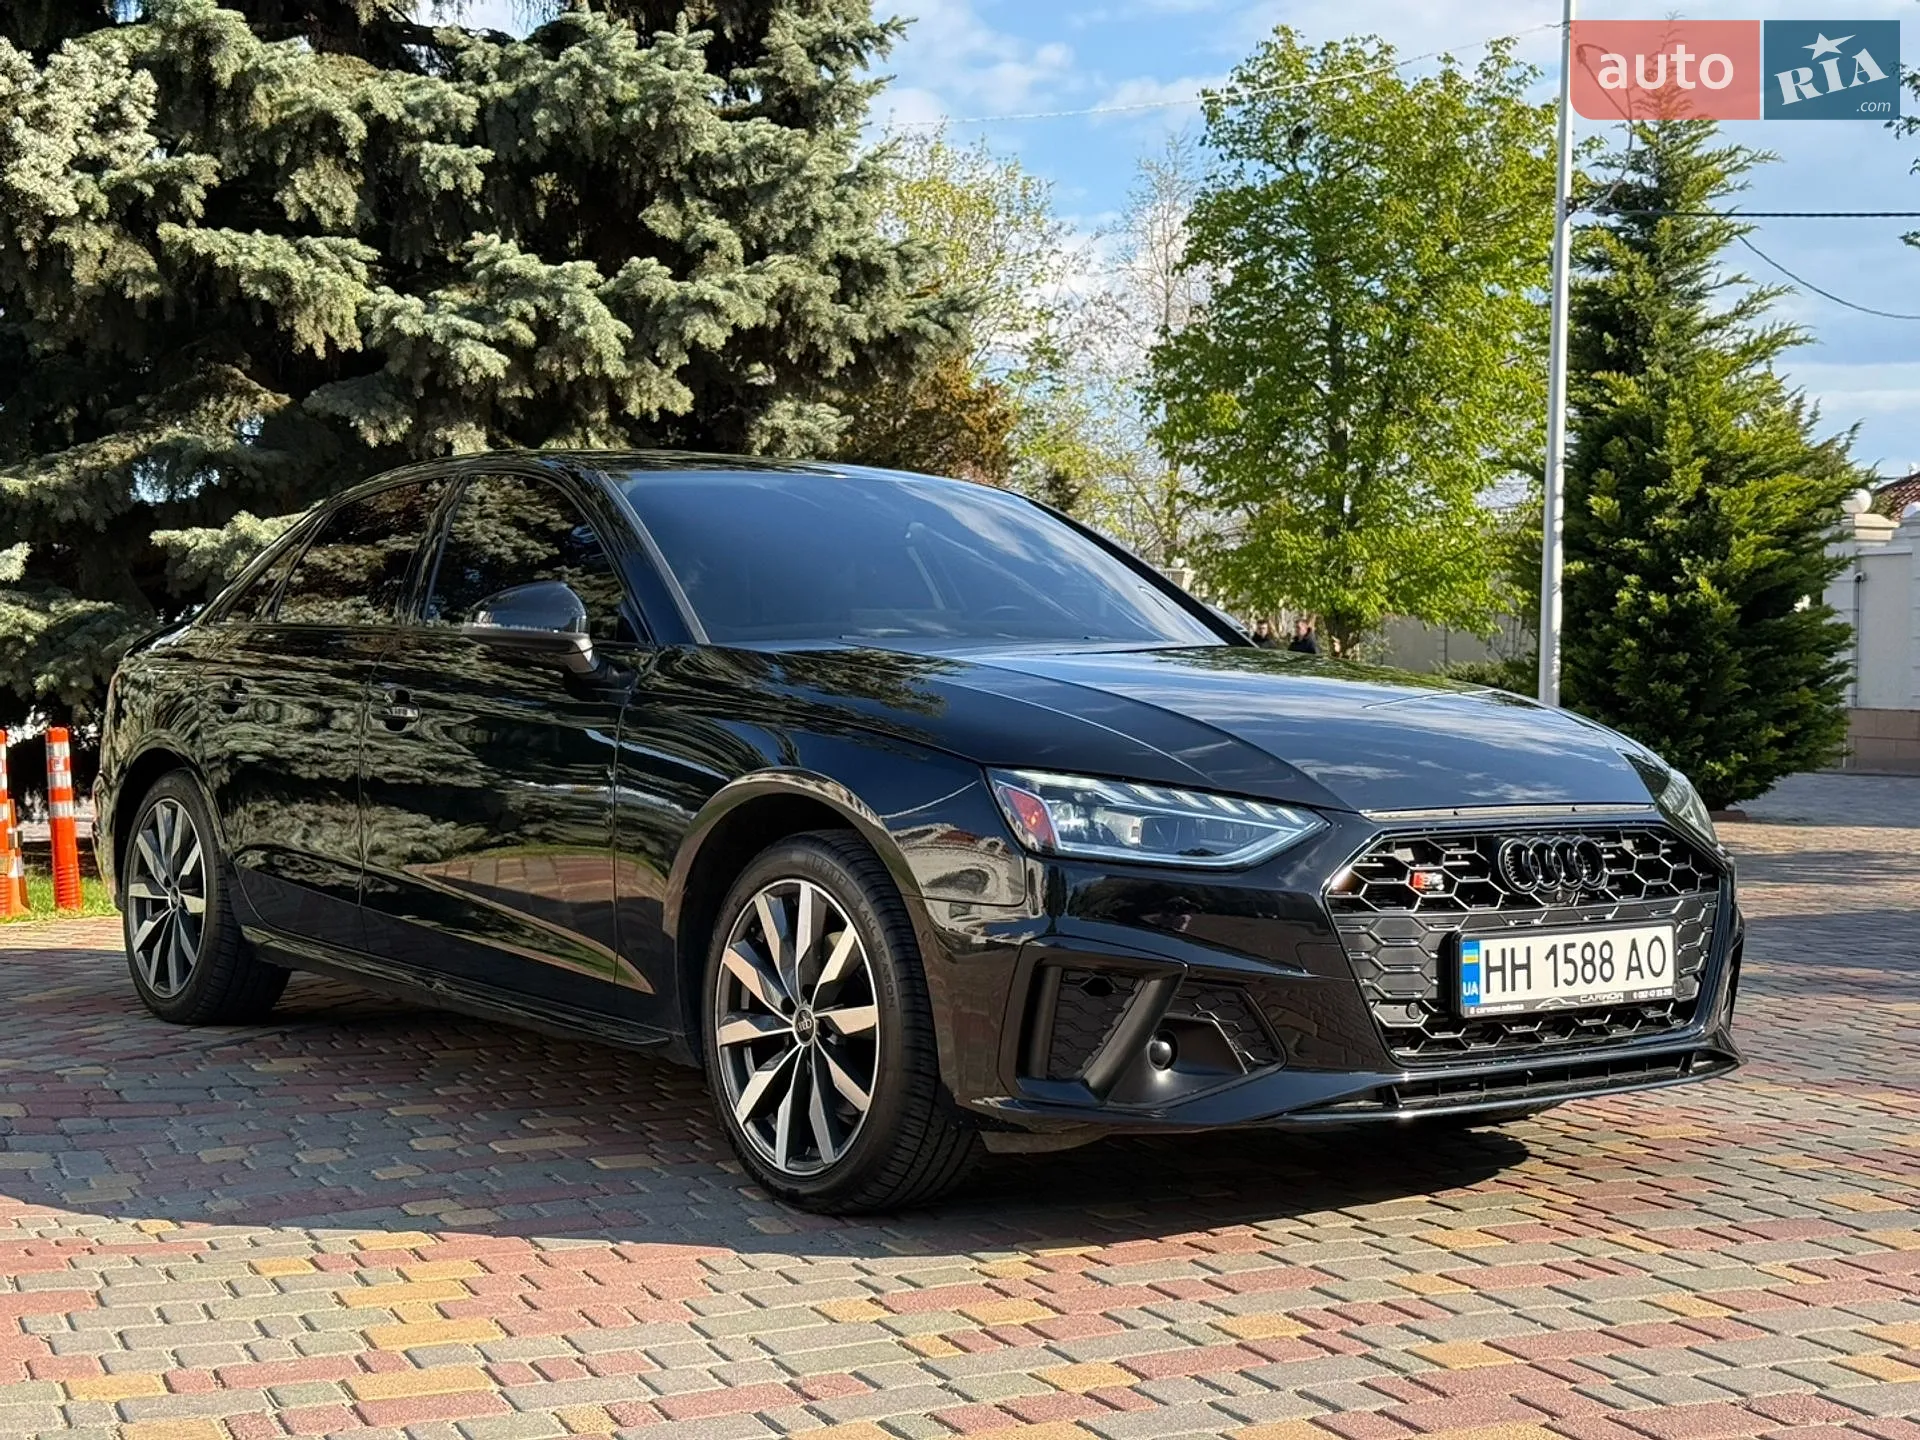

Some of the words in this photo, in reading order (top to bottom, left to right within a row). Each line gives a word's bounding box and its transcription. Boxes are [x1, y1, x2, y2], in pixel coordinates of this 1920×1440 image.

[1485, 946, 1531, 994] HH
[1544, 940, 1615, 988] 1588
[1626, 935, 1666, 981] AO
[1463, 981, 1478, 996] UA
